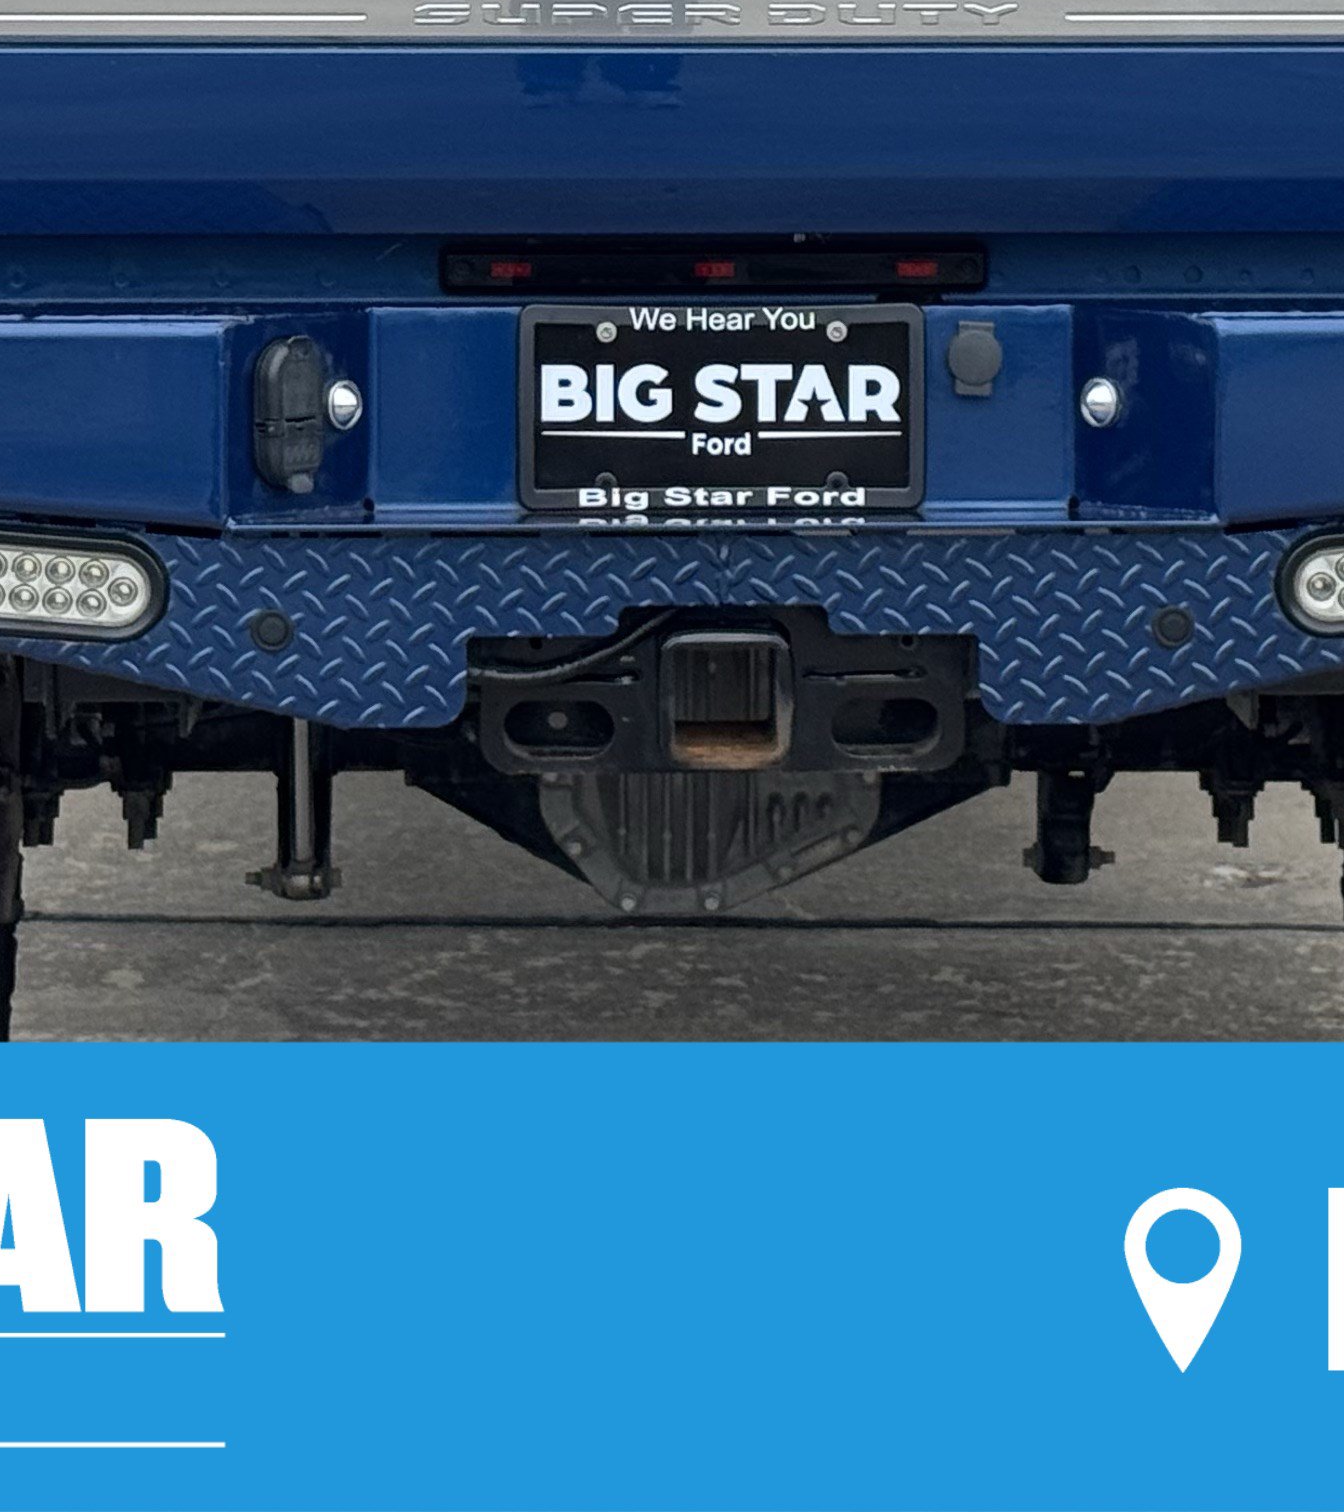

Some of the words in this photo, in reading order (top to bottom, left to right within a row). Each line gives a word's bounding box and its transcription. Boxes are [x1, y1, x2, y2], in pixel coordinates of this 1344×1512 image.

[413, 2, 740, 26] SUPER
[766, 2, 1018, 26] DUTY
[629, 307, 677, 331] We
[686, 307, 755, 331] Hear
[762, 306, 816, 331] You
[541, 363, 673, 423] BIG
[693, 363, 902, 423] STAR
[692, 431, 752, 456] Ford
[578, 487, 649, 511] Big
[664, 486, 754, 507] Star
[766, 486, 866, 507] Ford
